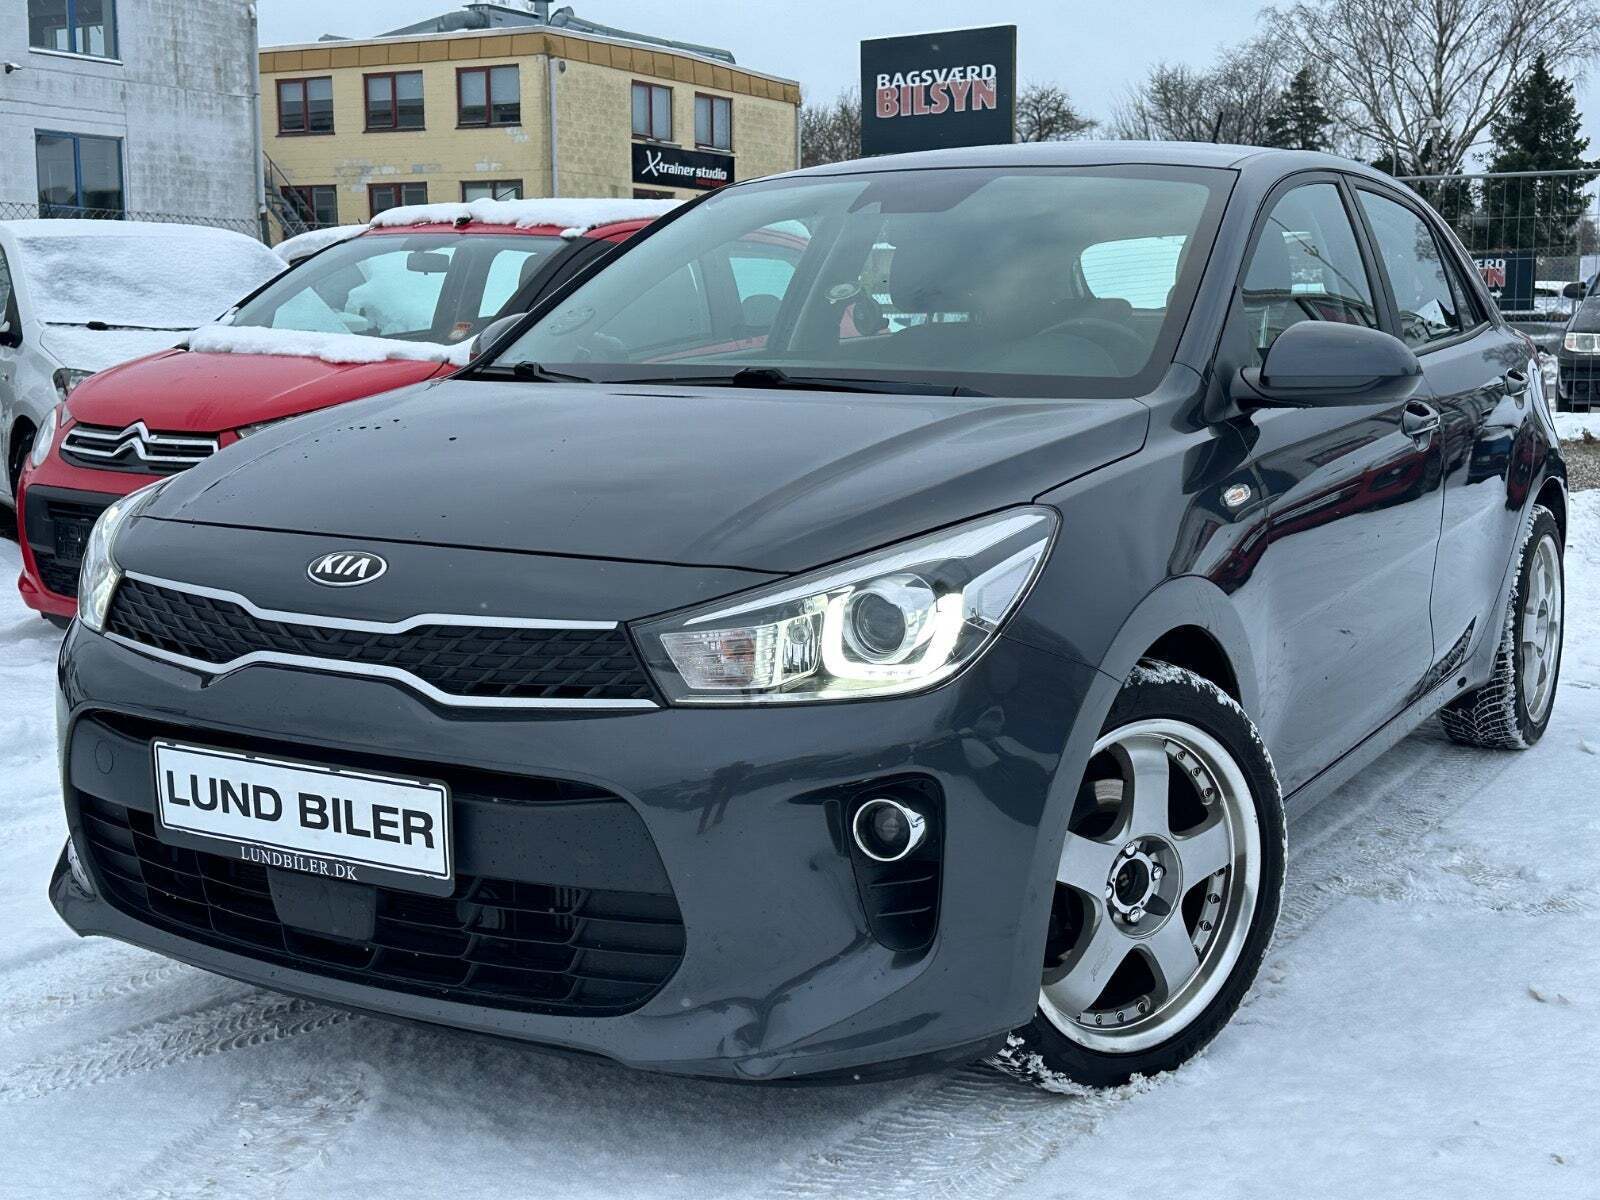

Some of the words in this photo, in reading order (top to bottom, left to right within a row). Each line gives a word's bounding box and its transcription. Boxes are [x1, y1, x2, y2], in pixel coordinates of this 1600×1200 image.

[876, 64, 997, 90] BAGSVÆRD
[876, 78, 997, 118] BILSYN
[641, 150, 696, 177] X-trainer
[696, 166, 727, 180] studio
[315, 554, 371, 578] KIA
[166, 770, 283, 823] LUND
[298, 791, 435, 849] BILER
[240, 846, 358, 881] LUNDBILER.DK
